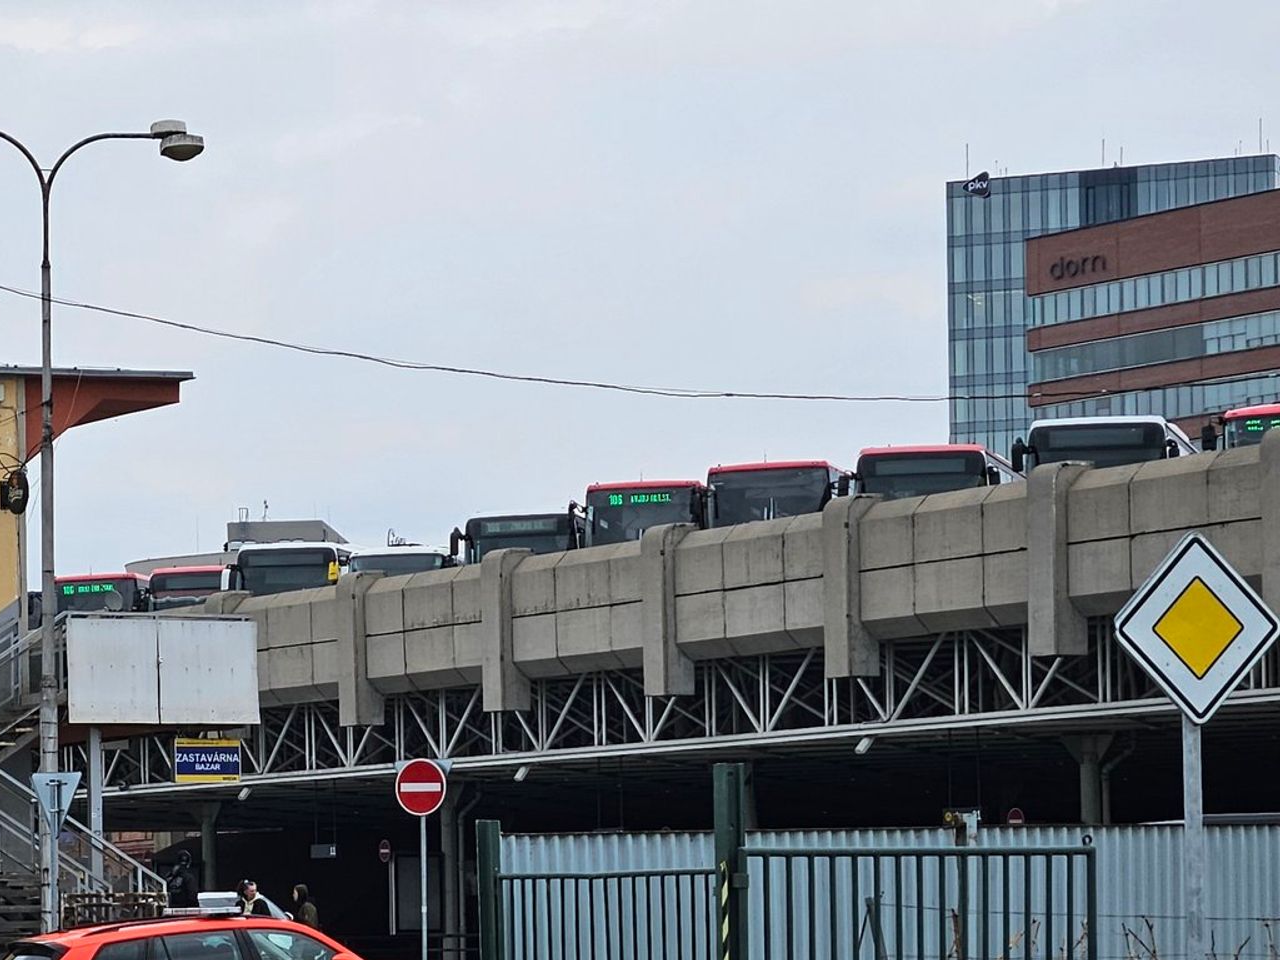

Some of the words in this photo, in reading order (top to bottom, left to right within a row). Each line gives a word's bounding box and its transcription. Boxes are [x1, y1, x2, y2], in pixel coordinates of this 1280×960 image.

[968, 179, 988, 190] pkv
[1050, 255, 1107, 281] dorn
[176, 752, 239, 763] ZASTAVÁRNA
